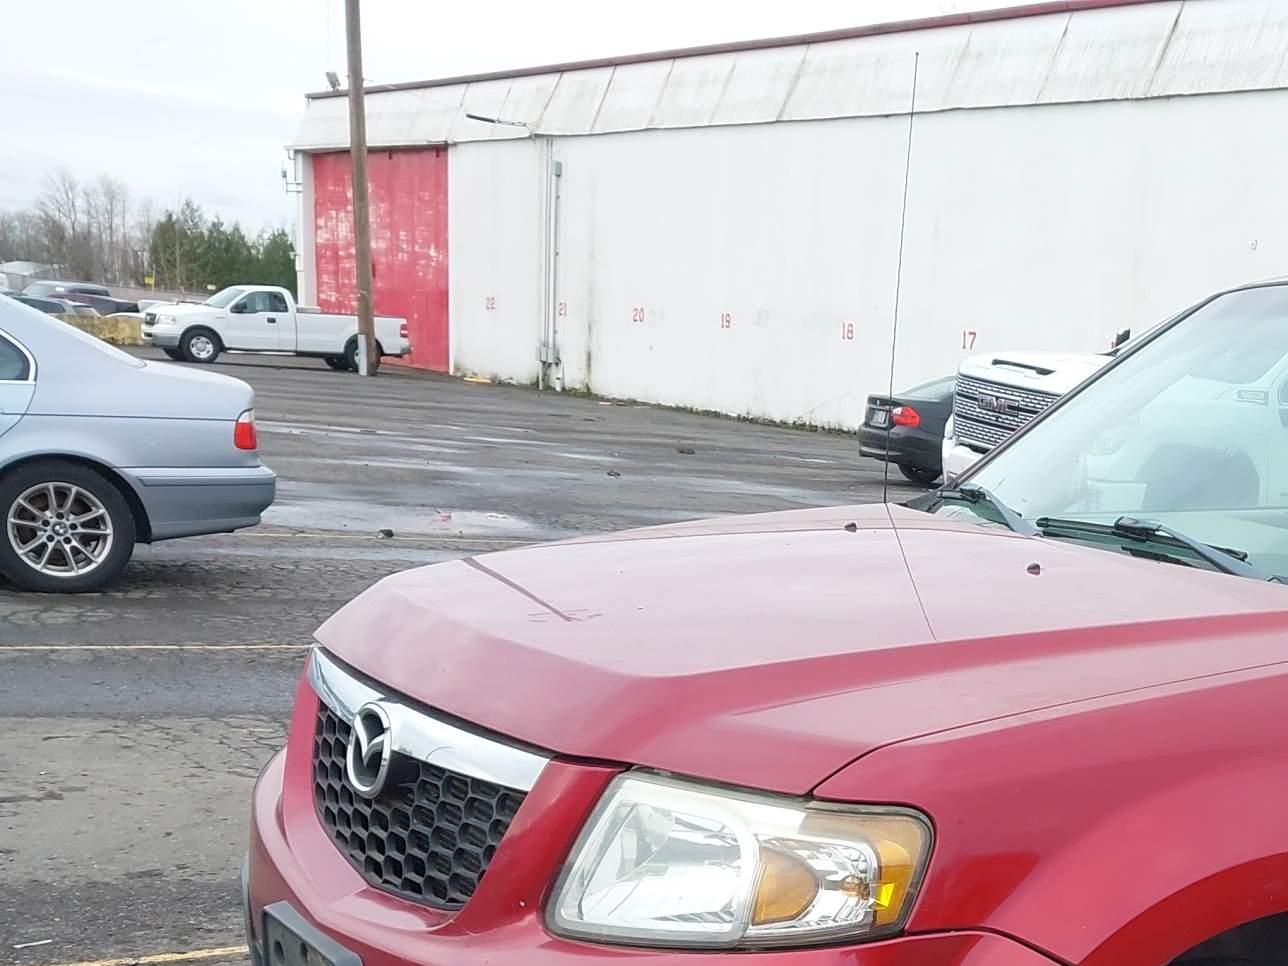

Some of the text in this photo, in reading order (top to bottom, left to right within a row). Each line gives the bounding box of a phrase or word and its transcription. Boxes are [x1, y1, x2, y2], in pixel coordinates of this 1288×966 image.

[633, 308, 645, 323] 20
[721, 313, 732, 329] 19
[842, 323, 854, 340] 18
[962, 331, 977, 350] 17
[977, 393, 1020, 417] GMC
